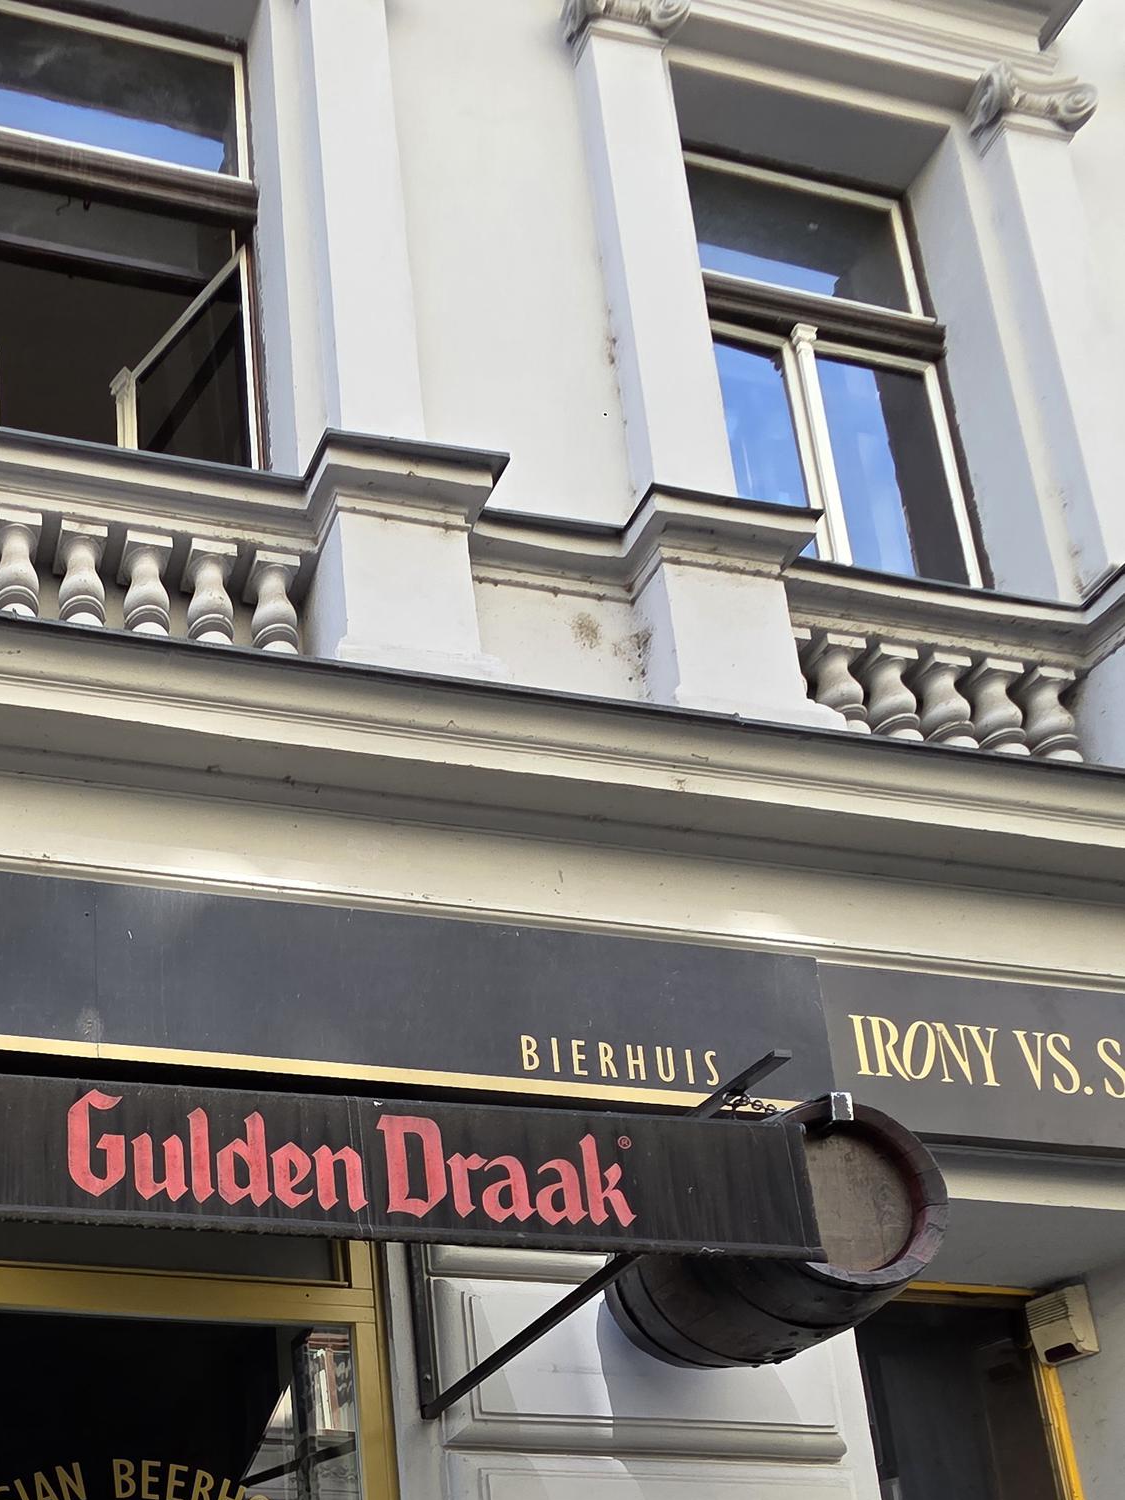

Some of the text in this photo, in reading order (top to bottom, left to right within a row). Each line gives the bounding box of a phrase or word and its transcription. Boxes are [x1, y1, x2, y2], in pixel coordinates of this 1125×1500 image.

[520, 1034, 720, 1086] BIERHUIS
[848, 1014, 1001, 1087] IRONY
[1012, 1030, 1094, 1095] VS.
[66, 1089, 369, 1213] Gulden
